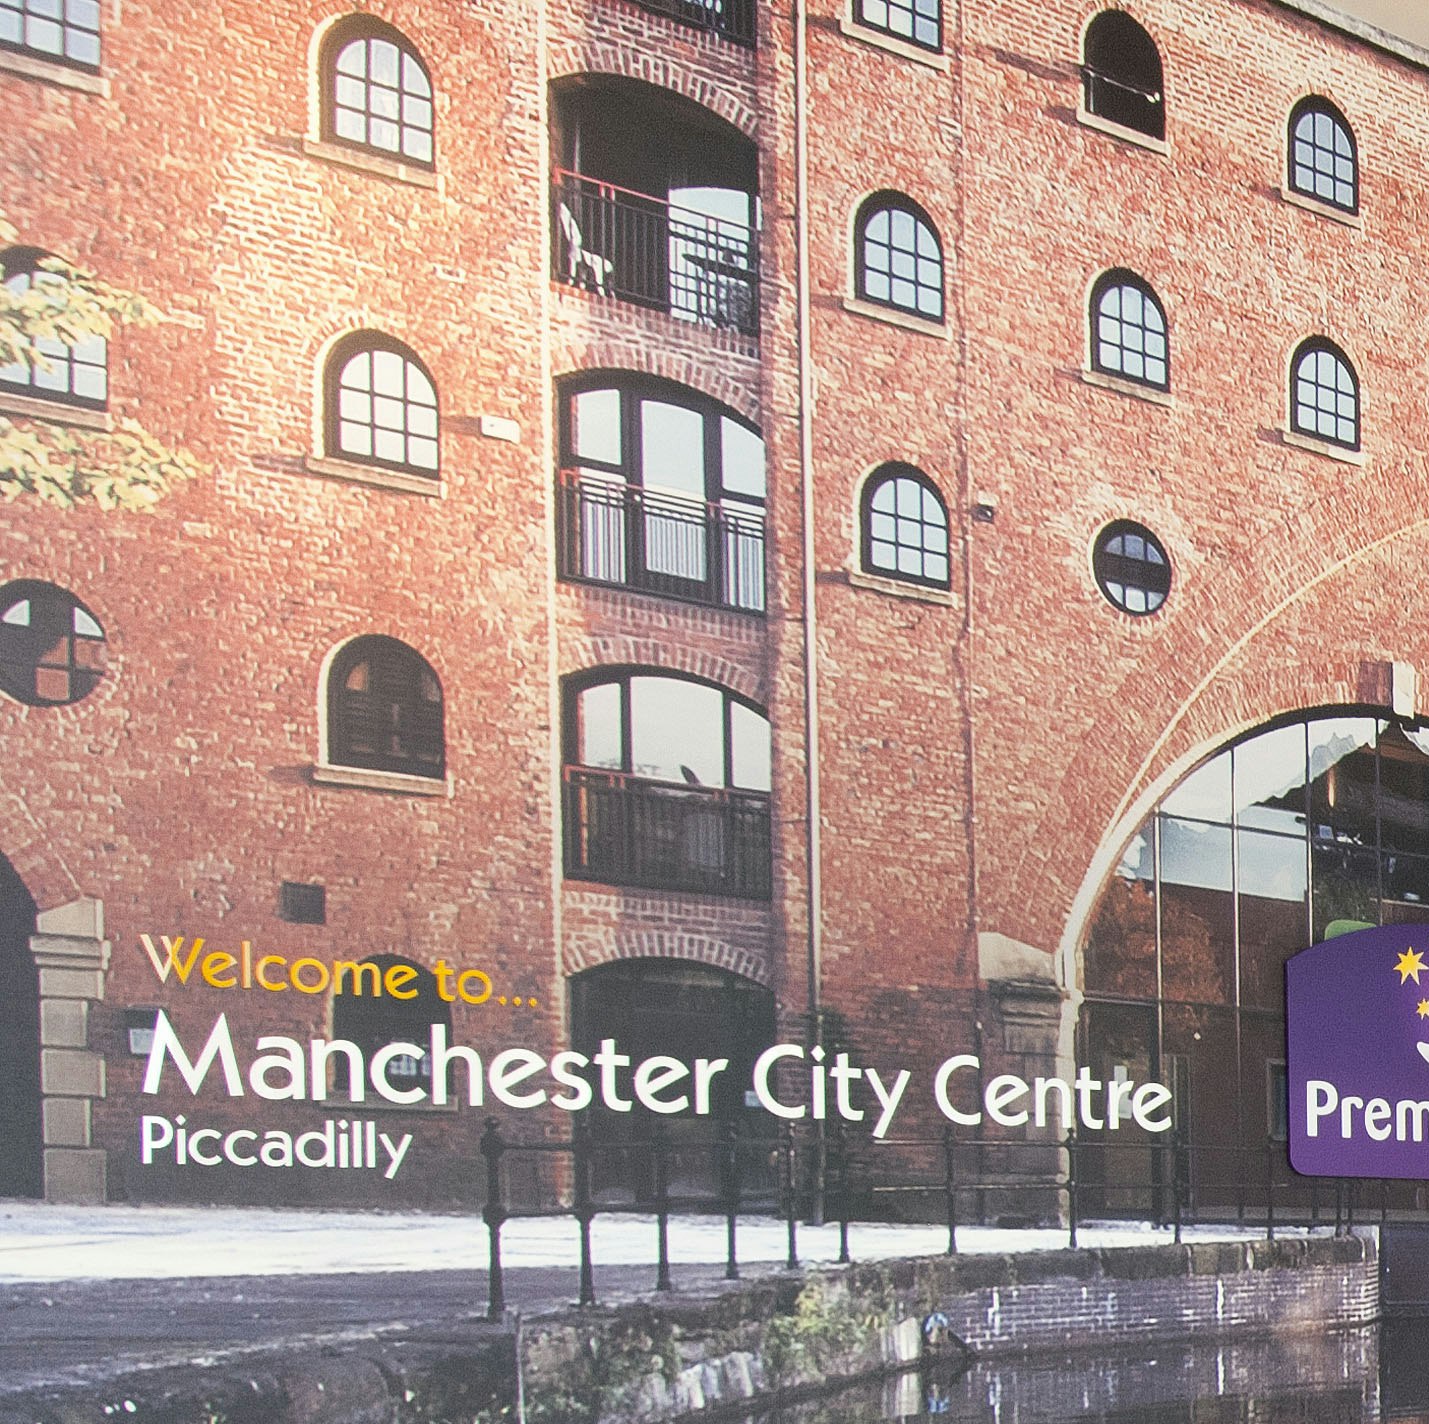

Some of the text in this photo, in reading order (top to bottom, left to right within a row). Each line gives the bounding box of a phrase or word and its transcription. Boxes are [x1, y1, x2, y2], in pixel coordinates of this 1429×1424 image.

[140, 933, 419, 1000] Welcome
[142, 1008, 1173, 1138] Manchester City Centre
[142, 1114, 413, 1179] Piccadilly
